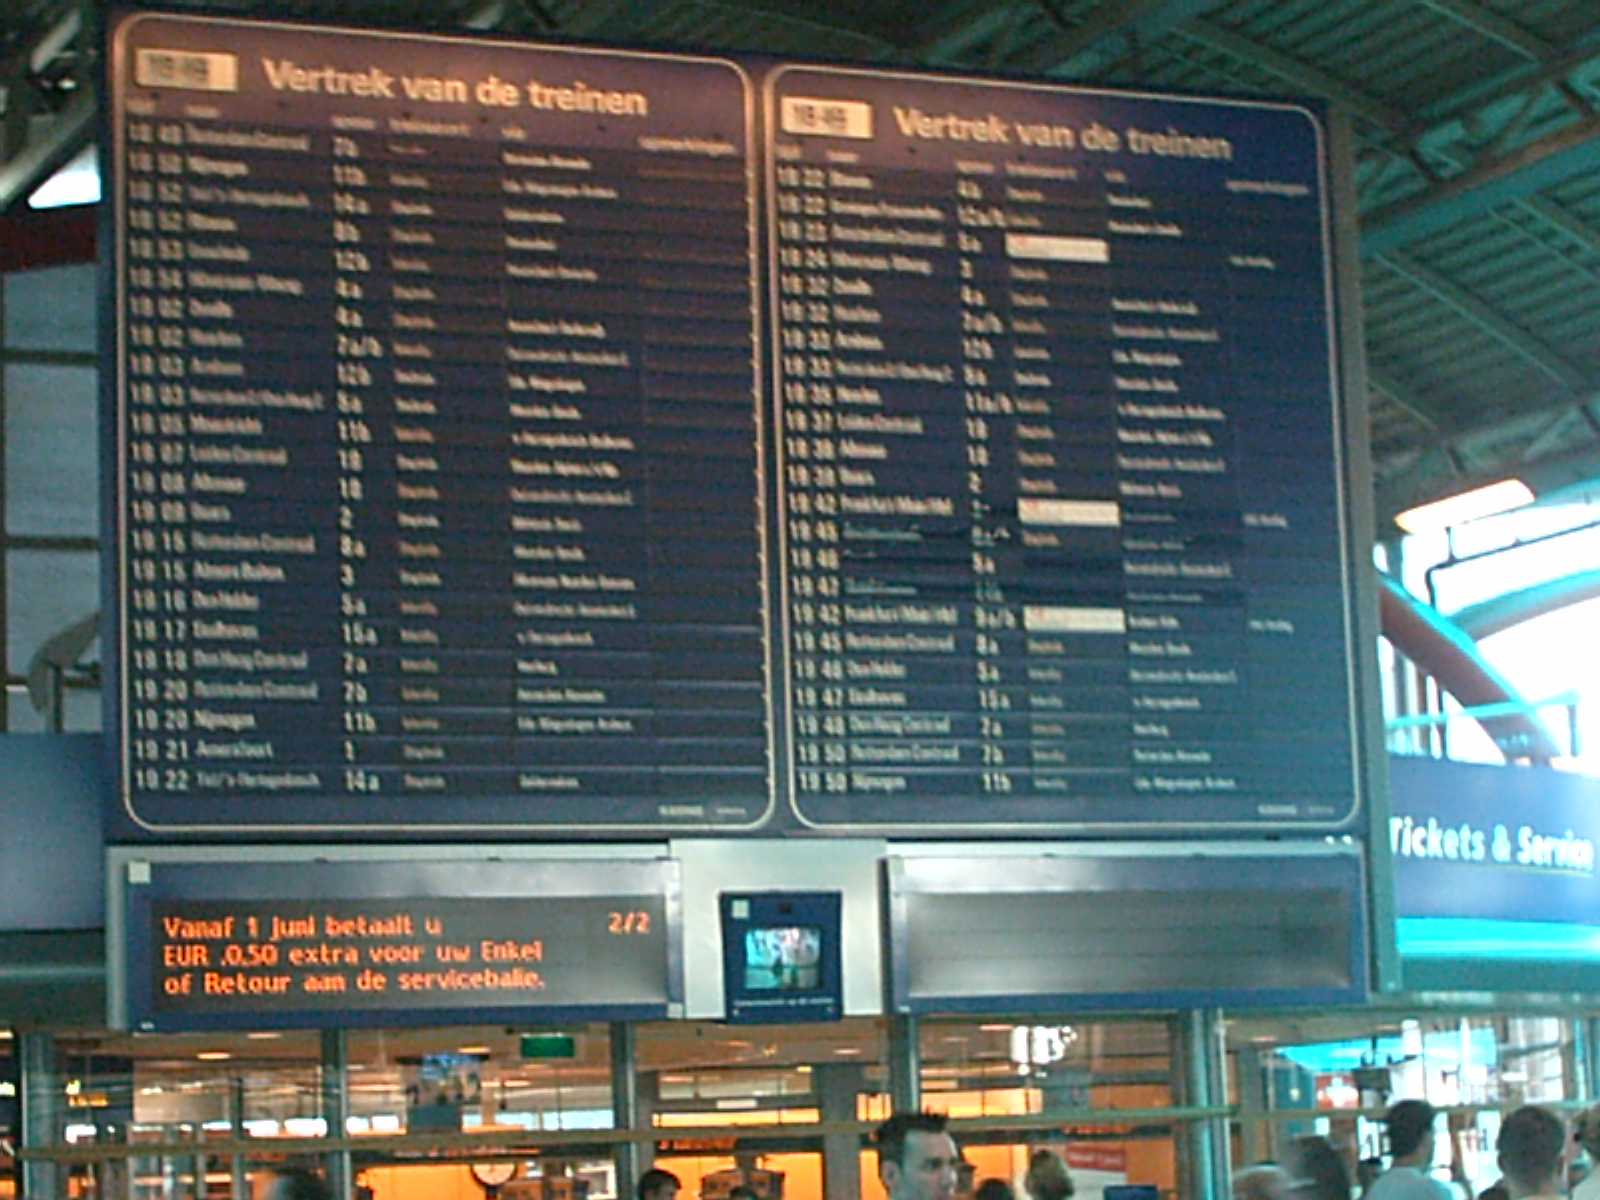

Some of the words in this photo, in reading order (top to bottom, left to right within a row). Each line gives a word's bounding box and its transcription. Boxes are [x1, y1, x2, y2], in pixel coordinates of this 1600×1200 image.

[262, 57, 394, 99] Vertrek
[402, 75, 469, 104] van
[474, 73, 520, 107] de
[526, 80, 649, 116] treinen
[893, 105, 1010, 144] Vertrek
[1014, 121, 1076, 150] van
[1080, 120, 1120, 152] de
[1125, 126, 1233, 161] treinen
[1389, 815, 1485, 861] Tickets
[1491, 823, 1511, 863] &
[163, 916, 234, 938] Vanaf
[247, 916, 259, 937] 1
[269, 915, 316, 942] juni
[325, 914, 414, 937] betaalt
[424, 917, 443, 936] u
[608, 911, 650, 934] 2/2
[163, 945, 210, 967] EUR
[288, 943, 360, 965] extra
[369, 944, 425, 963] voor
[435, 944, 471, 962] uw
[481, 940, 542, 961] Enkel
[164, 972, 193, 995] of
[204, 971, 291, 994] Retour
[303, 975, 346, 992] aan
[356, 969, 387, 991] de
[397, 967, 545, 990] servicebalie.
